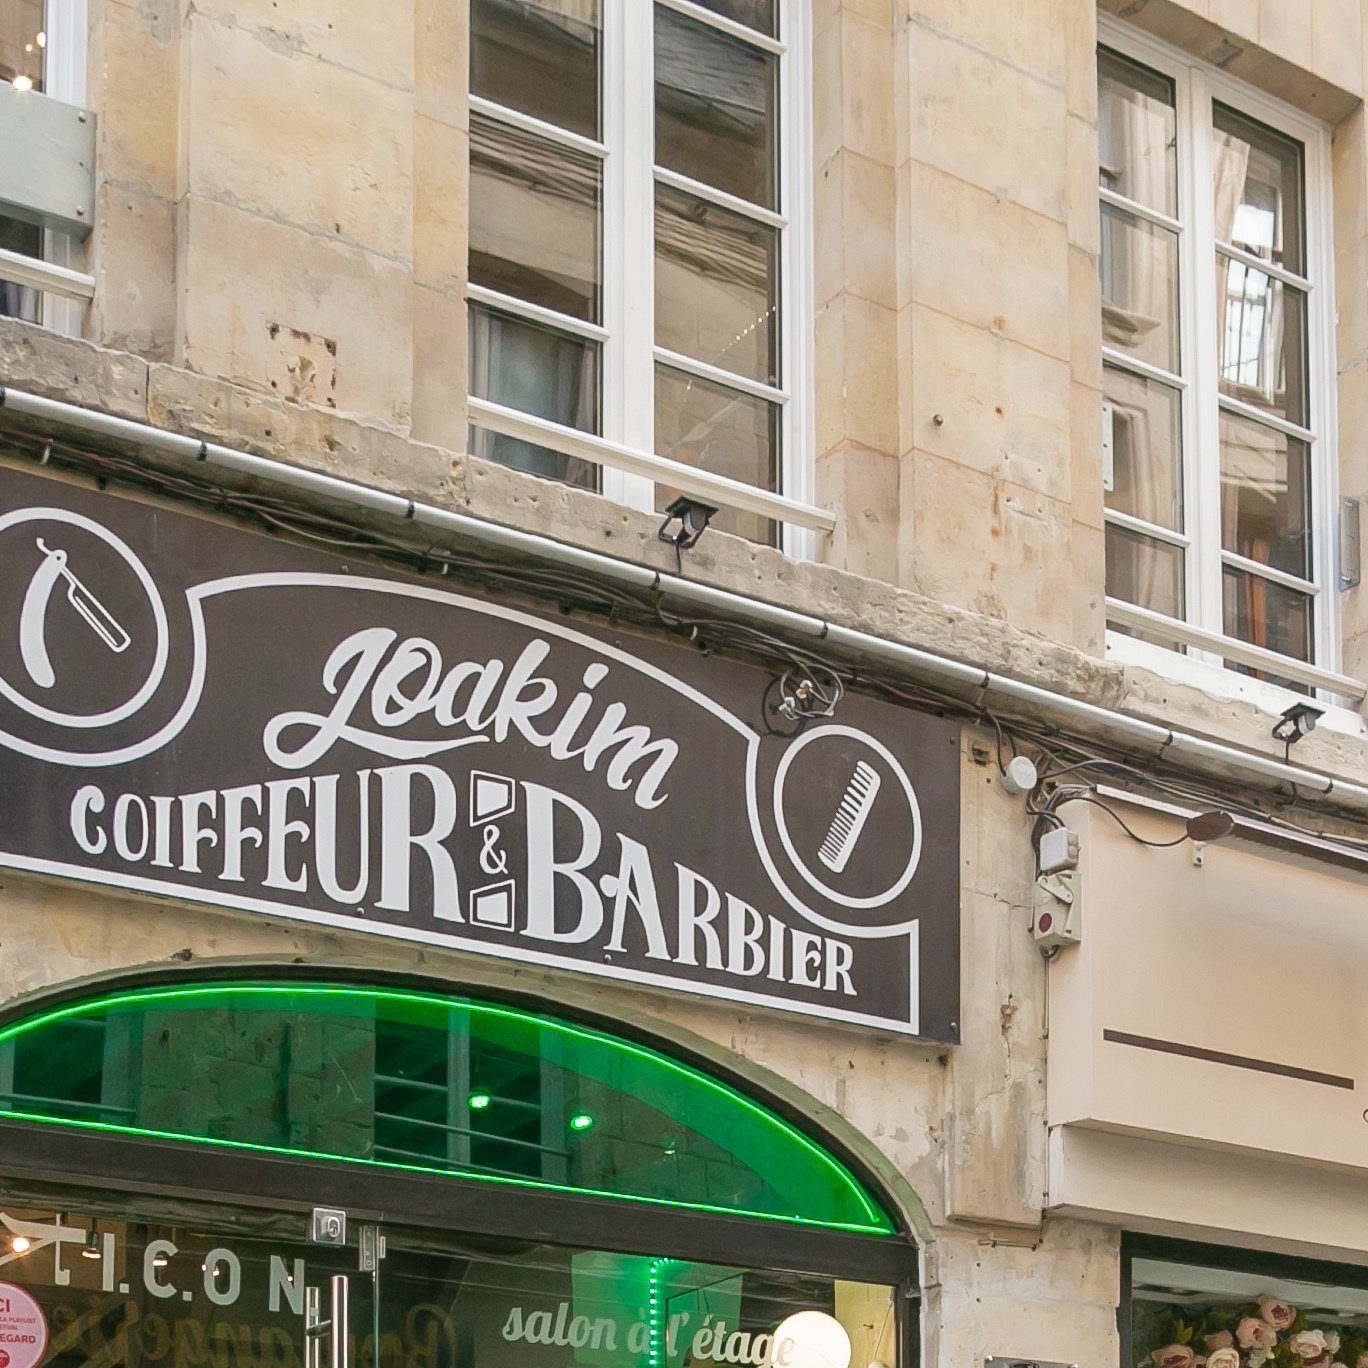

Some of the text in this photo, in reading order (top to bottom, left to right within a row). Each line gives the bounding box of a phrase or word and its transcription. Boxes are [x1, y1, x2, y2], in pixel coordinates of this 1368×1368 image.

[263, 626, 680, 811] Joakim
[70, 764, 859, 998] COIFFEUR & BARBIER
[502, 1302, 617, 1351] salon
